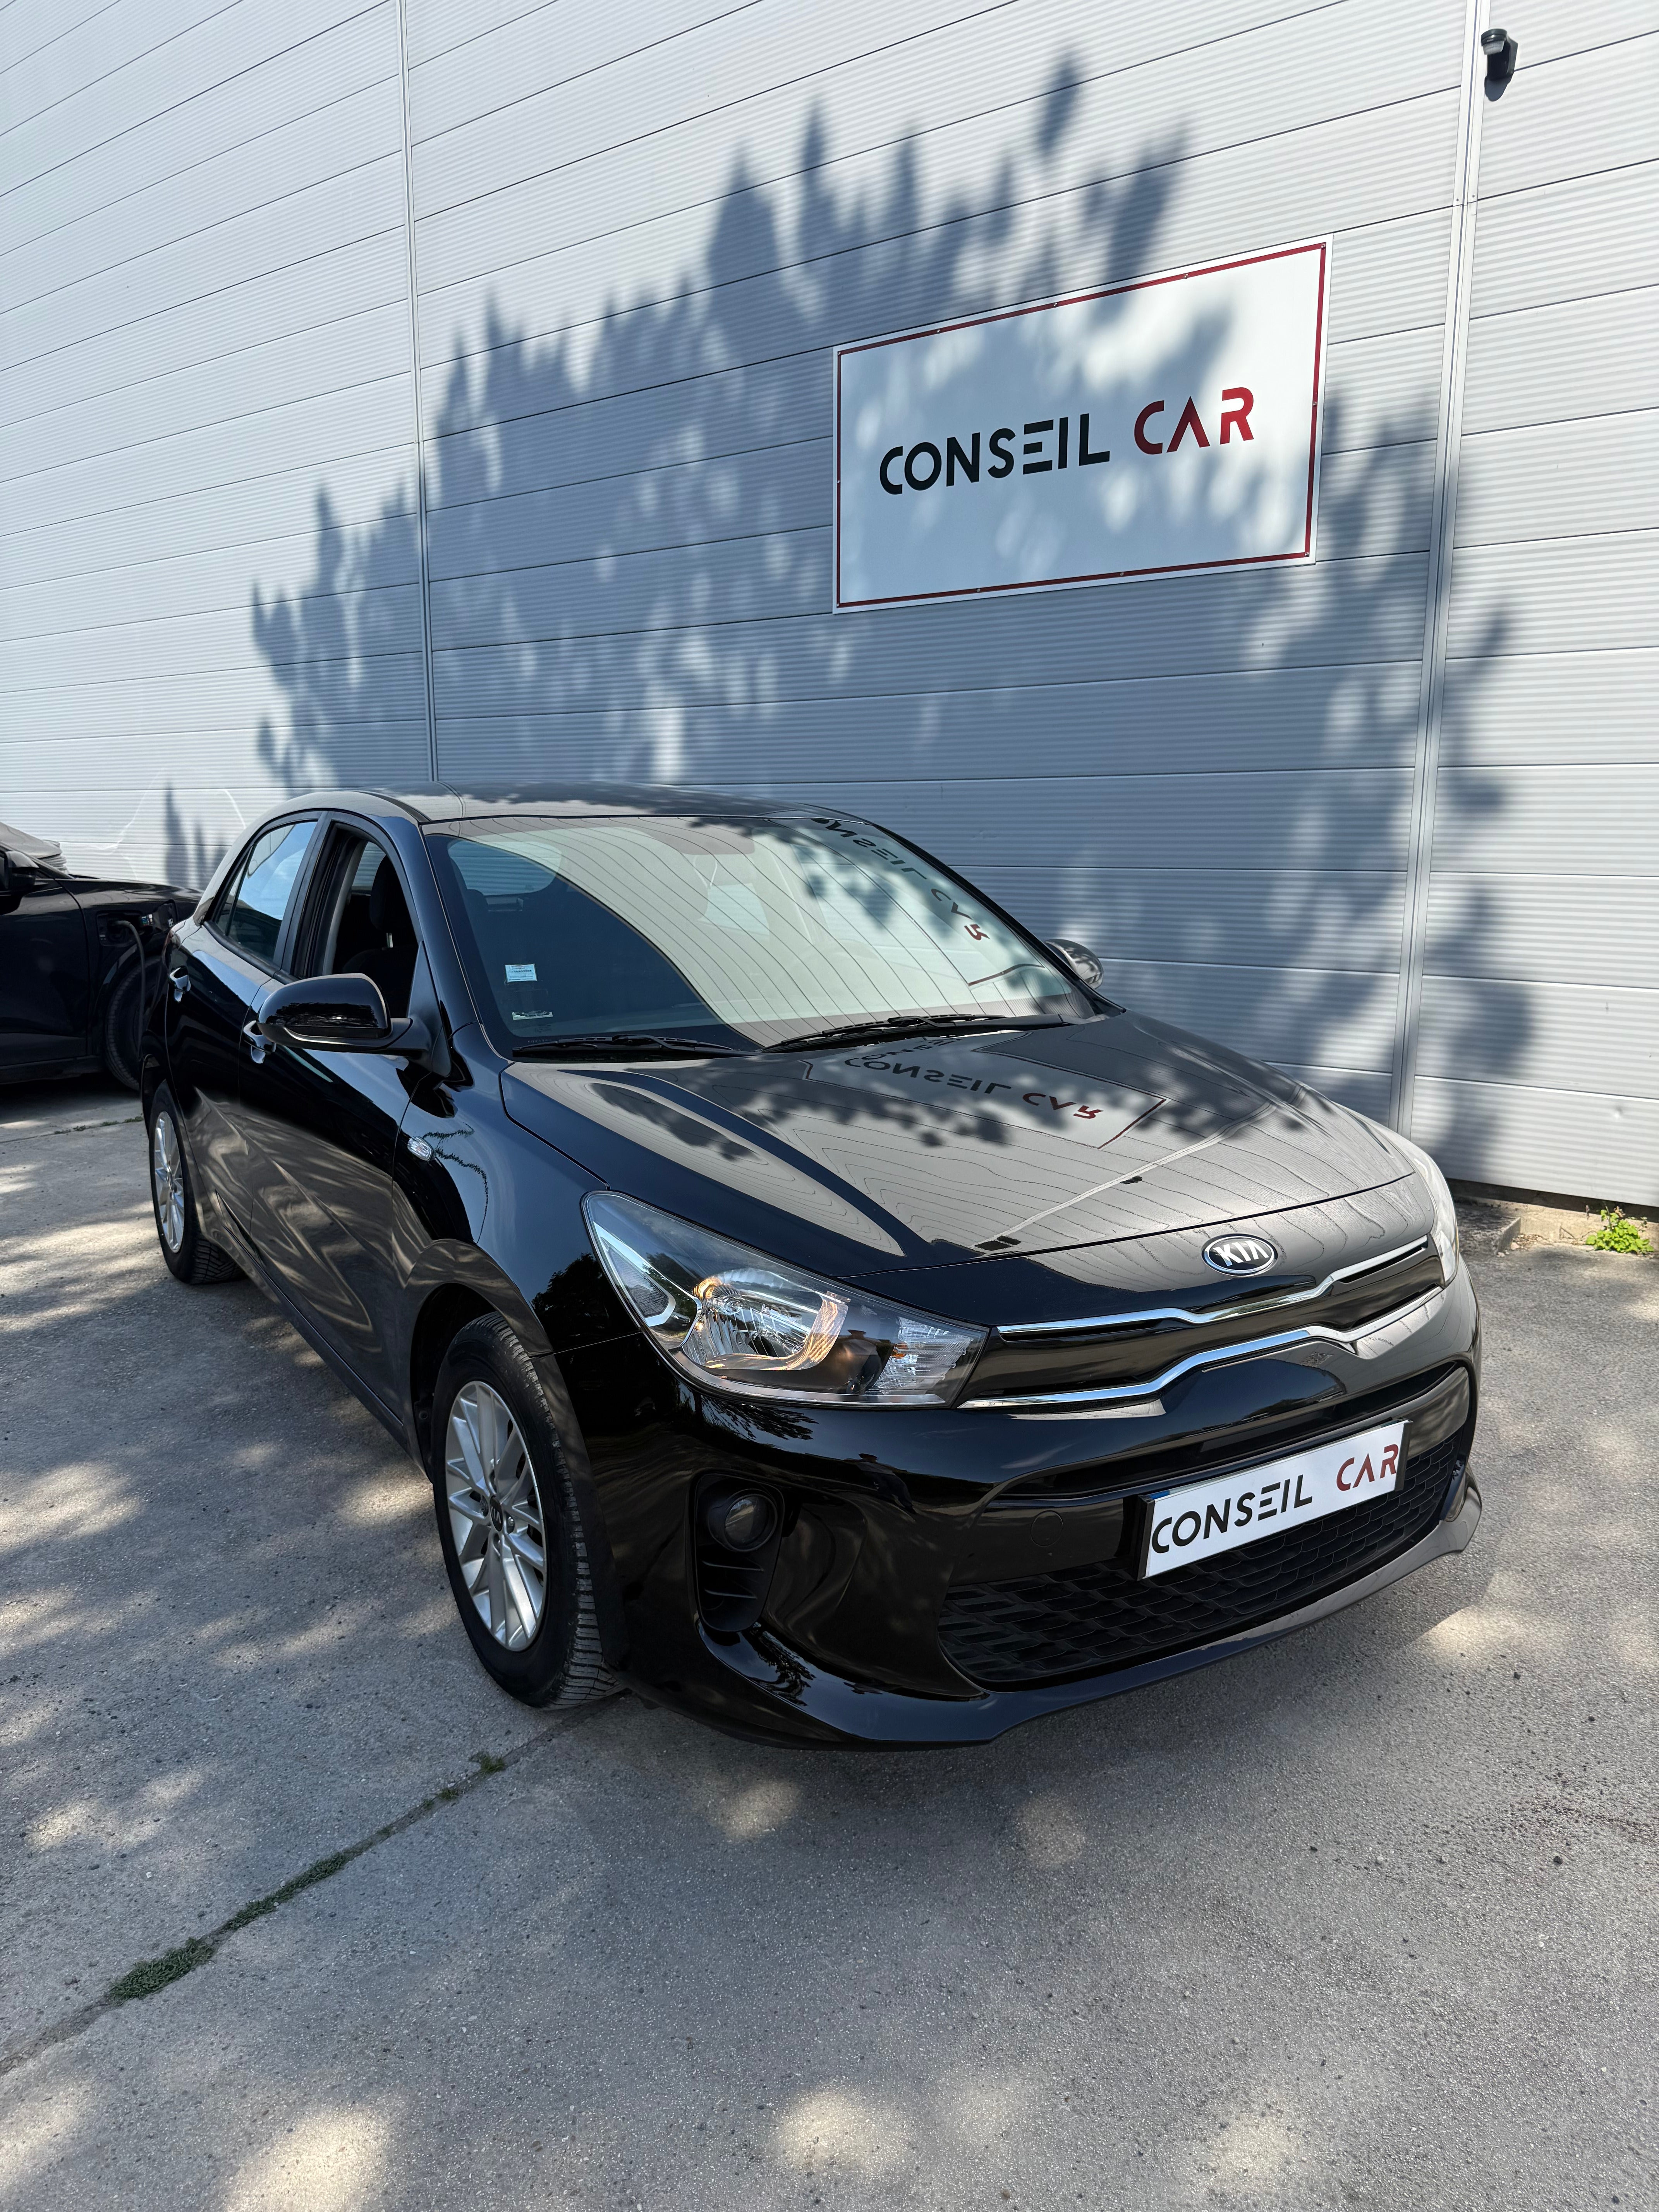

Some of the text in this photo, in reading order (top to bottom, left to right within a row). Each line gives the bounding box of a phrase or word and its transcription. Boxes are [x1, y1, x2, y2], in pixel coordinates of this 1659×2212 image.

[879, 387, 1254, 495] CONSEIL CAR
[1212, 1240, 1269, 1266] KIA
[1151, 1444, 1399, 1554] CONSEIL CAR
